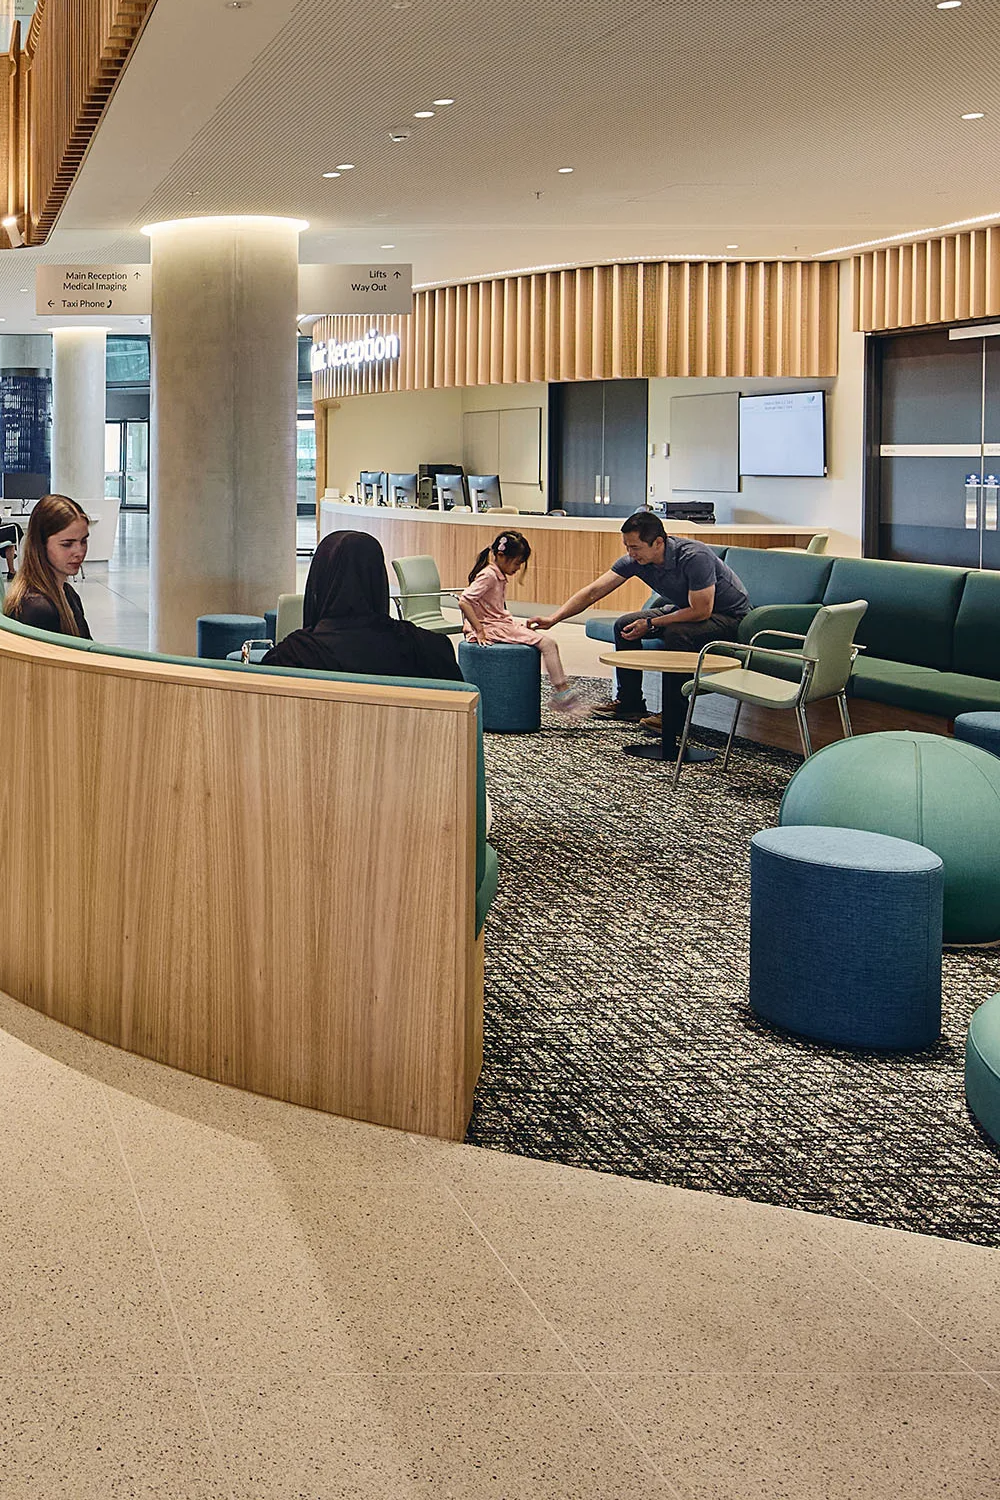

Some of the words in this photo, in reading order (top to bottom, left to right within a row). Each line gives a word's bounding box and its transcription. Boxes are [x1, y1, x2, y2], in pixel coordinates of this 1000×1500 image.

[65, 271, 87, 280] Main
[87, 271, 128, 282] Reception
[369, 270, 387, 279] Lifts
[63, 282, 94, 291] Medical
[96, 282, 127, 292] Imaging
[351, 283, 370, 292] Way
[371, 283, 387, 292] Out
[62, 299, 78, 308] Taxi
[80, 299, 105, 308] Phone
[328, 328, 400, 370] Reception
